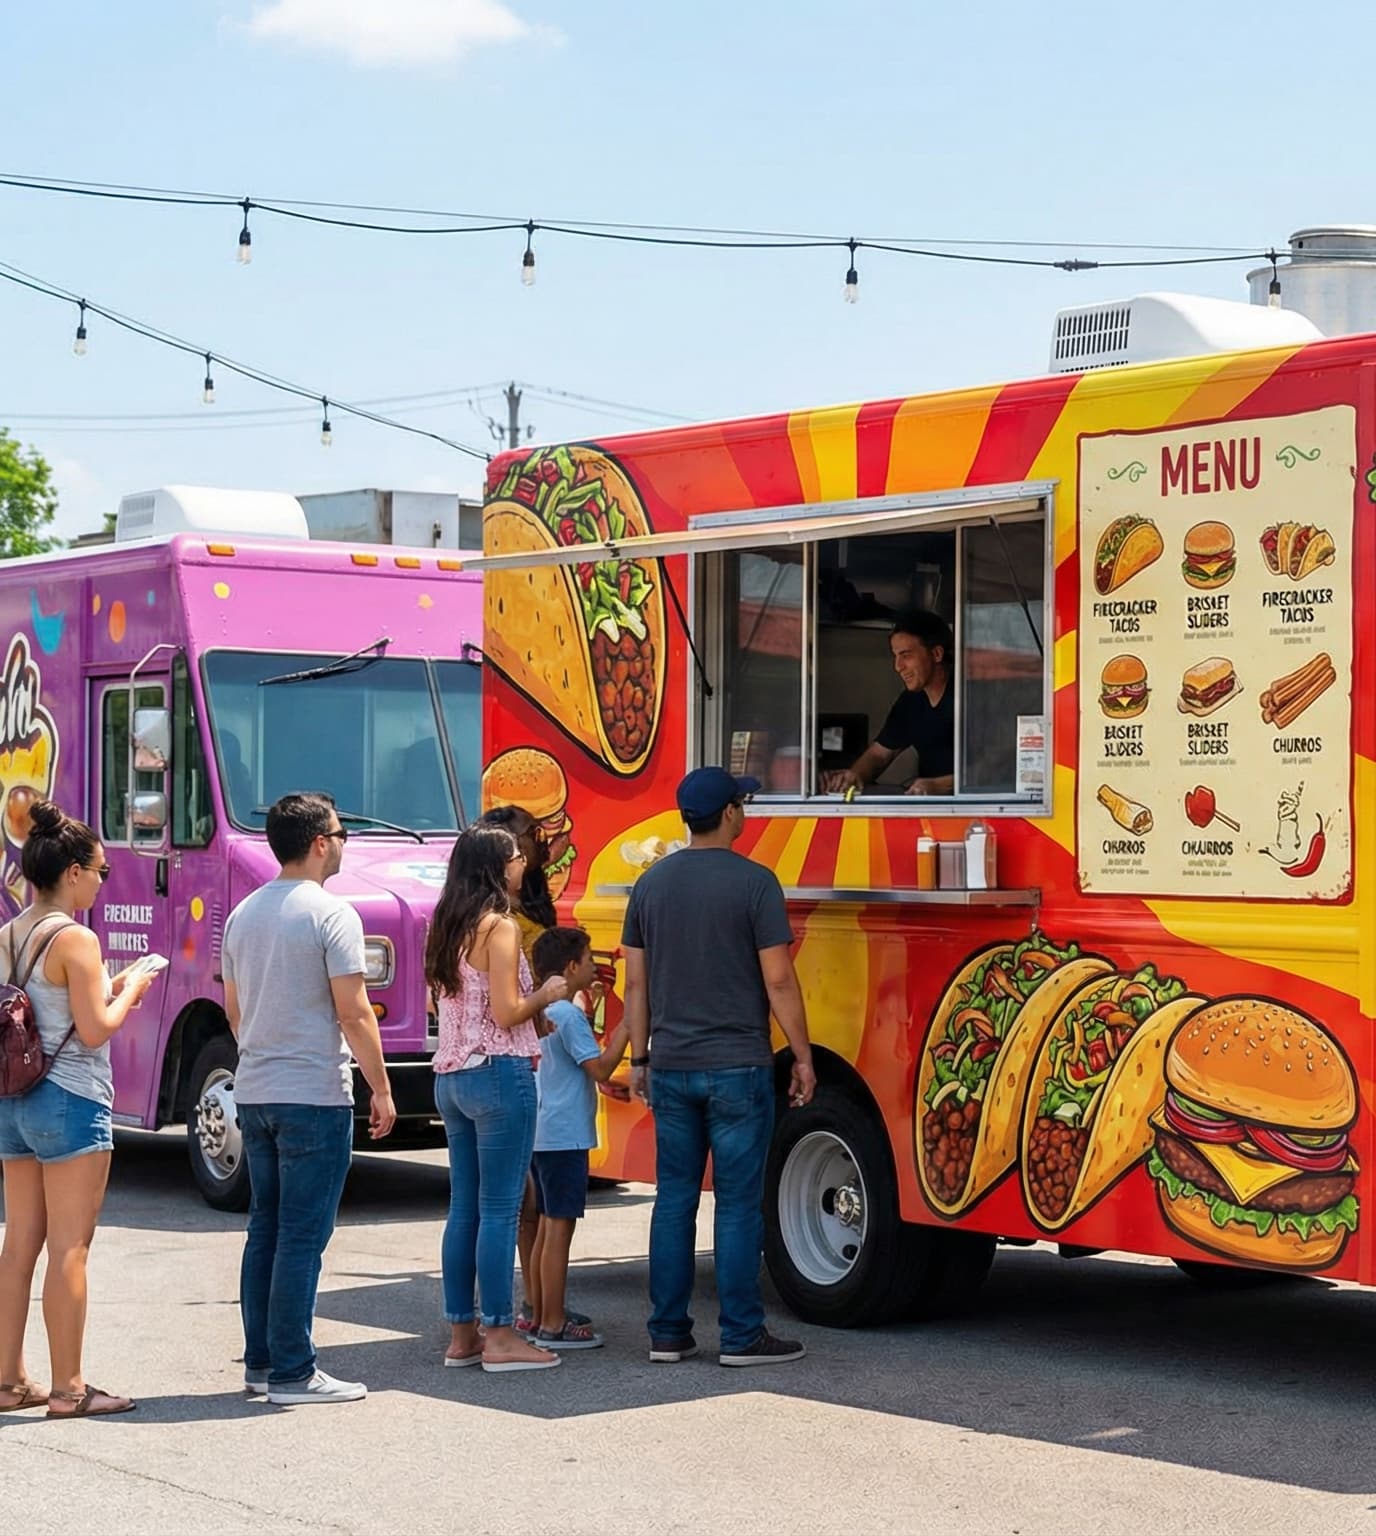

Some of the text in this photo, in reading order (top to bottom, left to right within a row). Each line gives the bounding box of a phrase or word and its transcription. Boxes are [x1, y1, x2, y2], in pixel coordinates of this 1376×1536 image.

[1161, 437, 1261, 496] MENU
[1109, 618, 1140, 633] TACOS
[1187, 740, 1229, 755] SLIDERS
[1273, 736, 1322, 753] CHURROS
